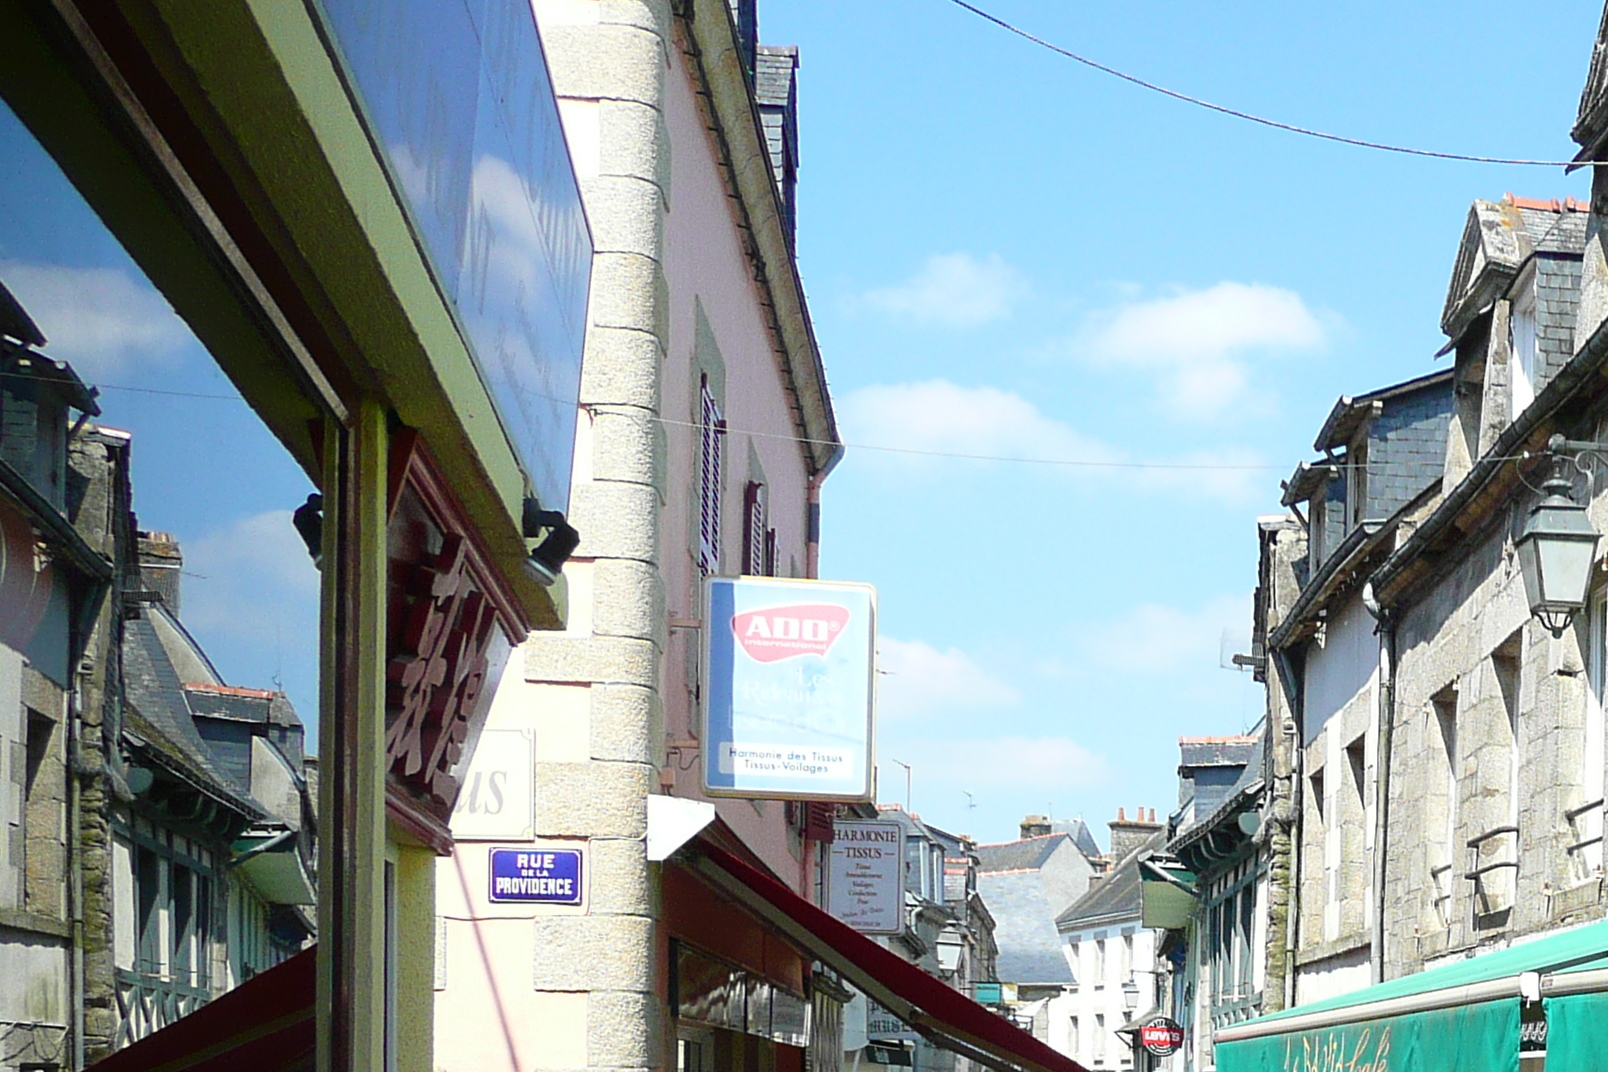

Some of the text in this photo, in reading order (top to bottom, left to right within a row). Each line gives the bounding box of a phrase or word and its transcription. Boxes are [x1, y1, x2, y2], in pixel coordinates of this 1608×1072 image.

[745, 616, 828, 641] ADO
[744, 639, 827, 651] international
[729, 748, 843, 763] Harmonie des Tissus
[834, 828, 897, 843] HARMONIE
[844, 847, 883, 859] TISSUS
[517, 854, 554, 868] RUE
[496, 878, 573, 896] PROVIDENCE
